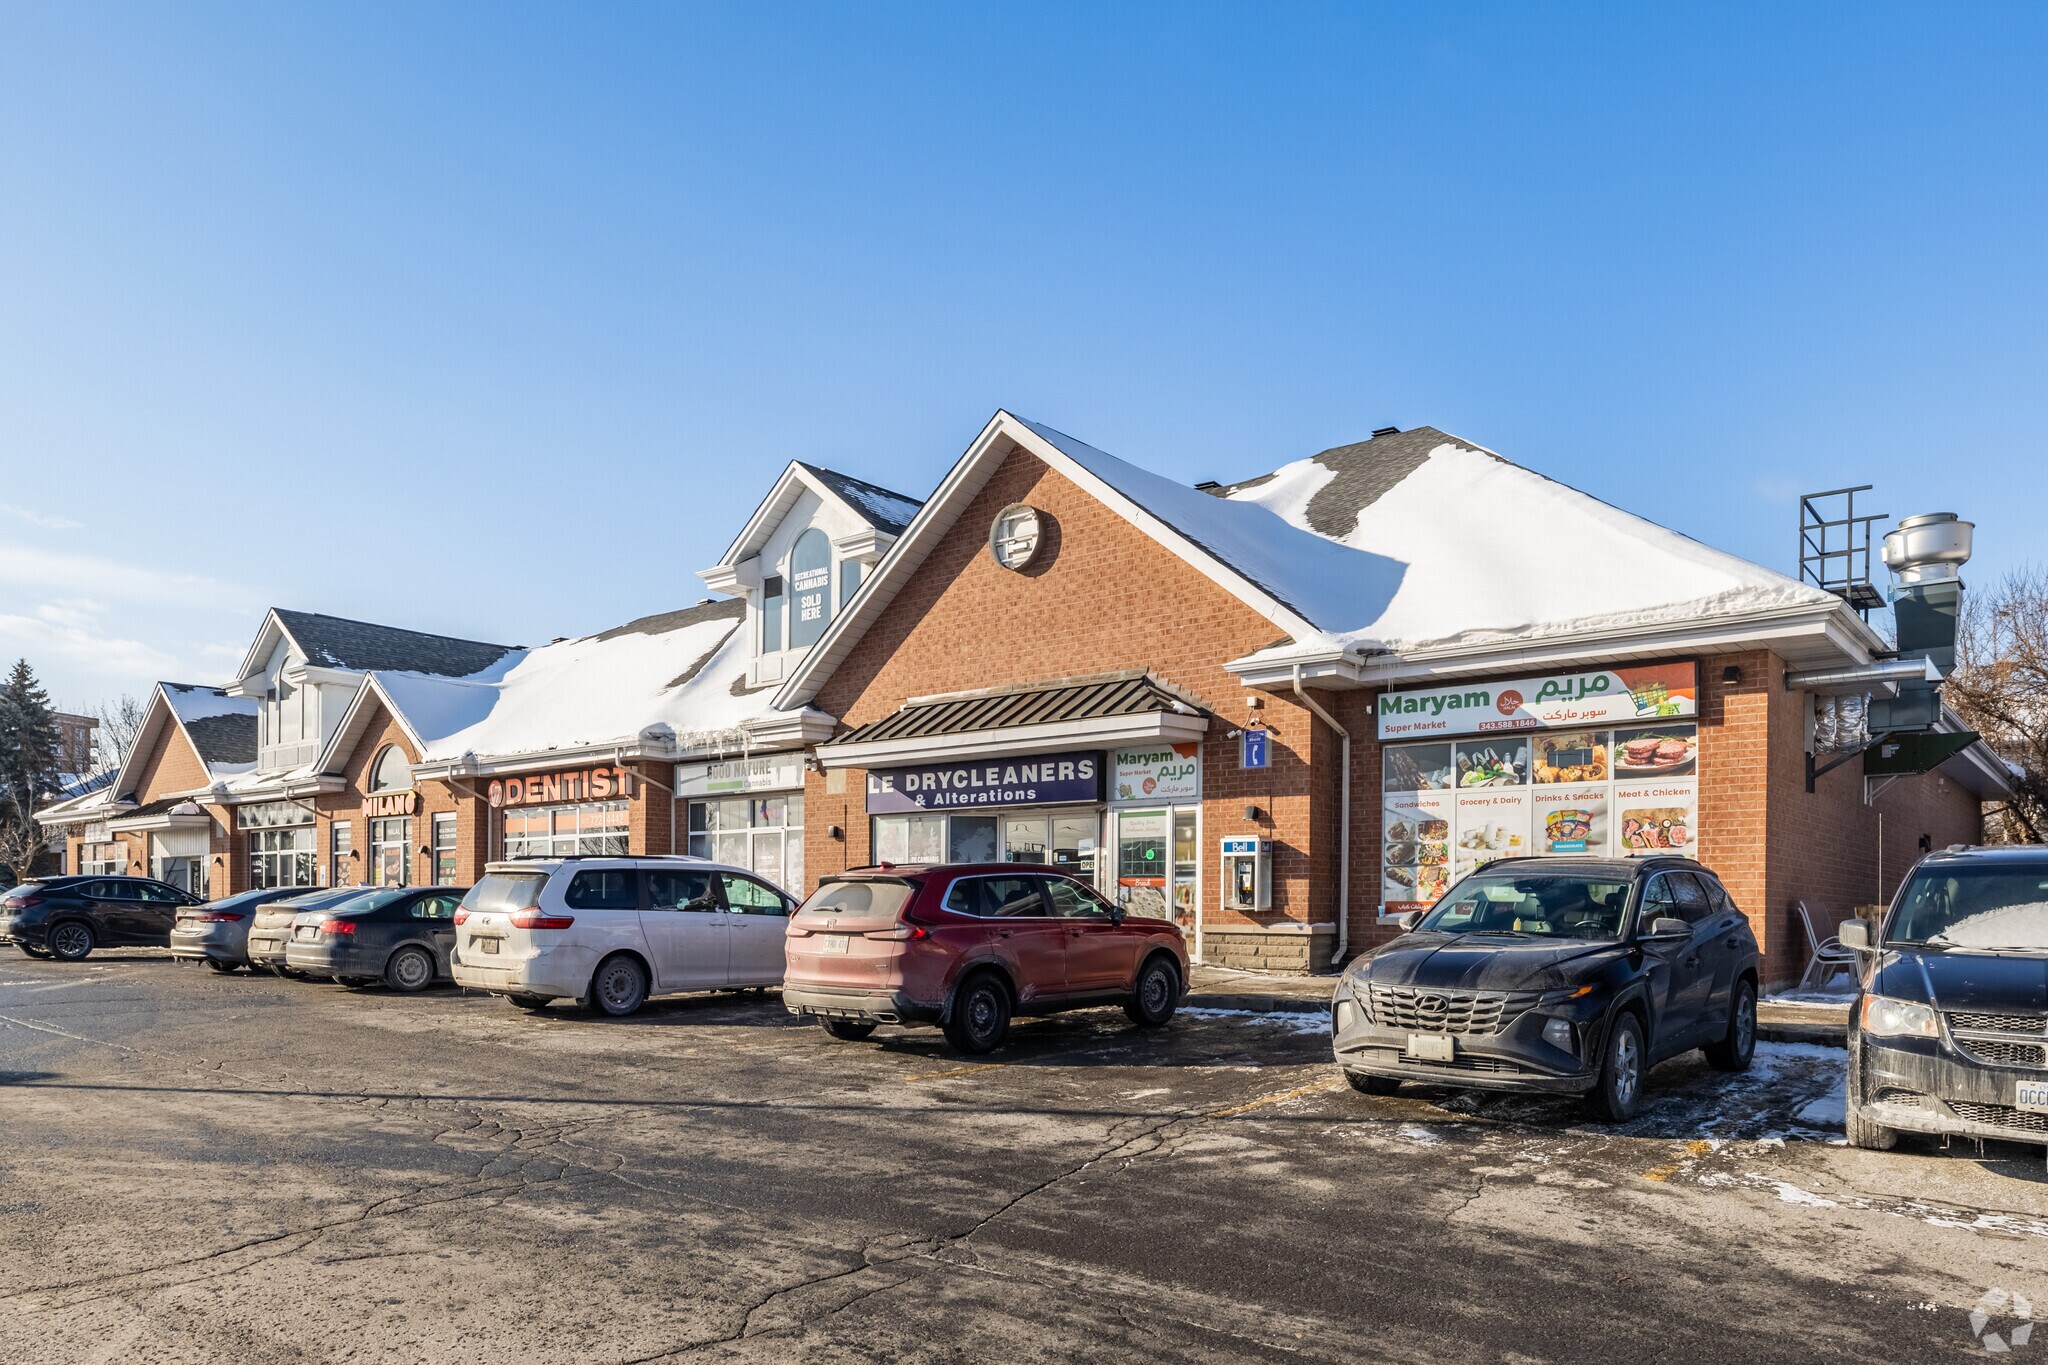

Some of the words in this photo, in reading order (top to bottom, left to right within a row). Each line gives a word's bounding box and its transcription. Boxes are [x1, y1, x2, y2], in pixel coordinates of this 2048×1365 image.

[795, 575, 828, 591] CANNABIS
[802, 594, 821, 608] SOLD
[802, 606, 821, 621] HERE
[1535, 675, 1610, 705] مريم
[1380, 691, 1490, 716] Maryam
[1543, 709, 1577, 720] ماركت
[1580, 709, 1607, 719] سوبر
[1385, 724, 1411, 733] Super
[1414, 721, 1446, 730] Market
[1480, 720, 1535, 731] 343.588.1846
[1117, 751, 1173, 766] Maryam
[707, 764, 731, 779] GOOD
[734, 760, 771, 776] NATURE
[868, 776, 894, 794] LE
[906, 760, 1094, 791] DRYCLEANERS
[1157, 764, 1195, 782] مريم
[505, 767, 629, 805] DENTIST
[744, 779, 771, 788] Cannabis
[915, 794, 926, 806] &
[934, 789, 1037, 805] Alterations
[1535, 794, 1562, 802] Drinks
[1572, 792, 1604, 800] Snacks
[1618, 790, 1641, 798] Meat
[1652, 788, 1691, 796] Chicken
[362, 793, 415, 817] MILANO
[1232, 842, 1248, 852] Bell
[1262, 842, 1270, 851] Bell
